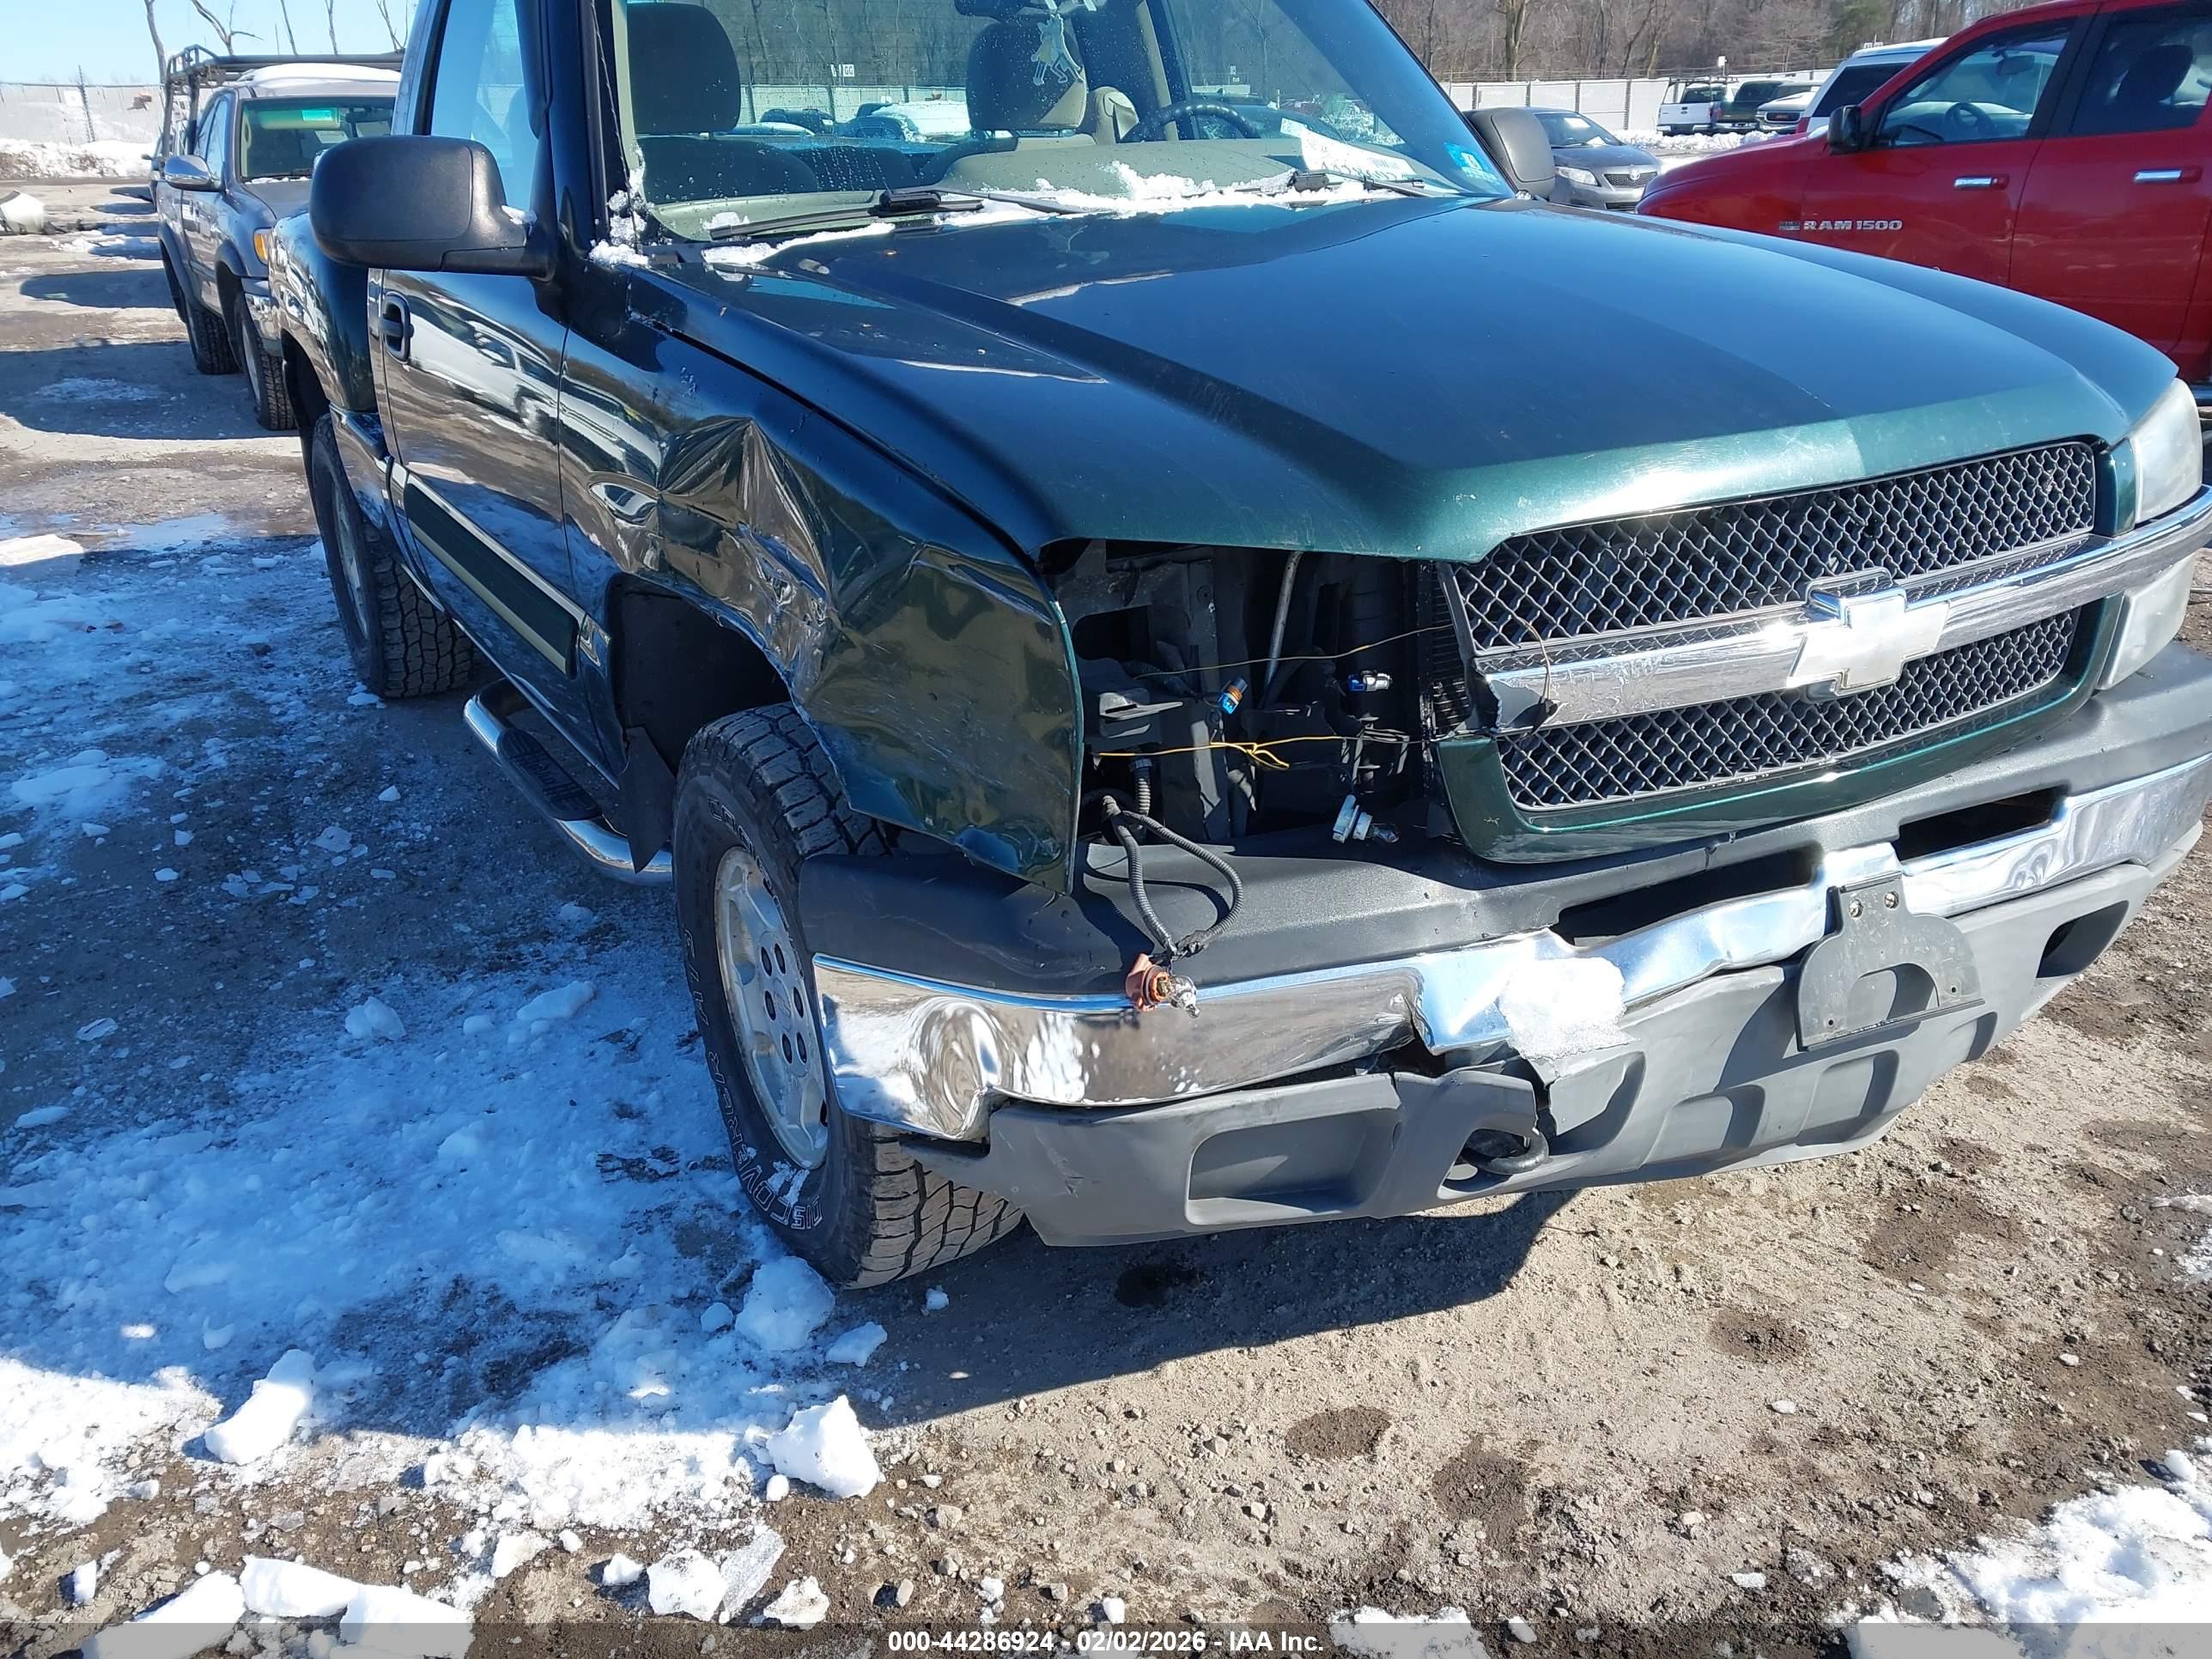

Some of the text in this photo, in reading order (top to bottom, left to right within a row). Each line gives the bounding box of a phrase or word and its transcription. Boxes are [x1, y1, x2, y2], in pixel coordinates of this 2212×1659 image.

[1803, 220, 1852, 230] RAM
[1856, 220, 1903, 230] 1500
[708, 1051, 823, 1230] DISCOVERER
